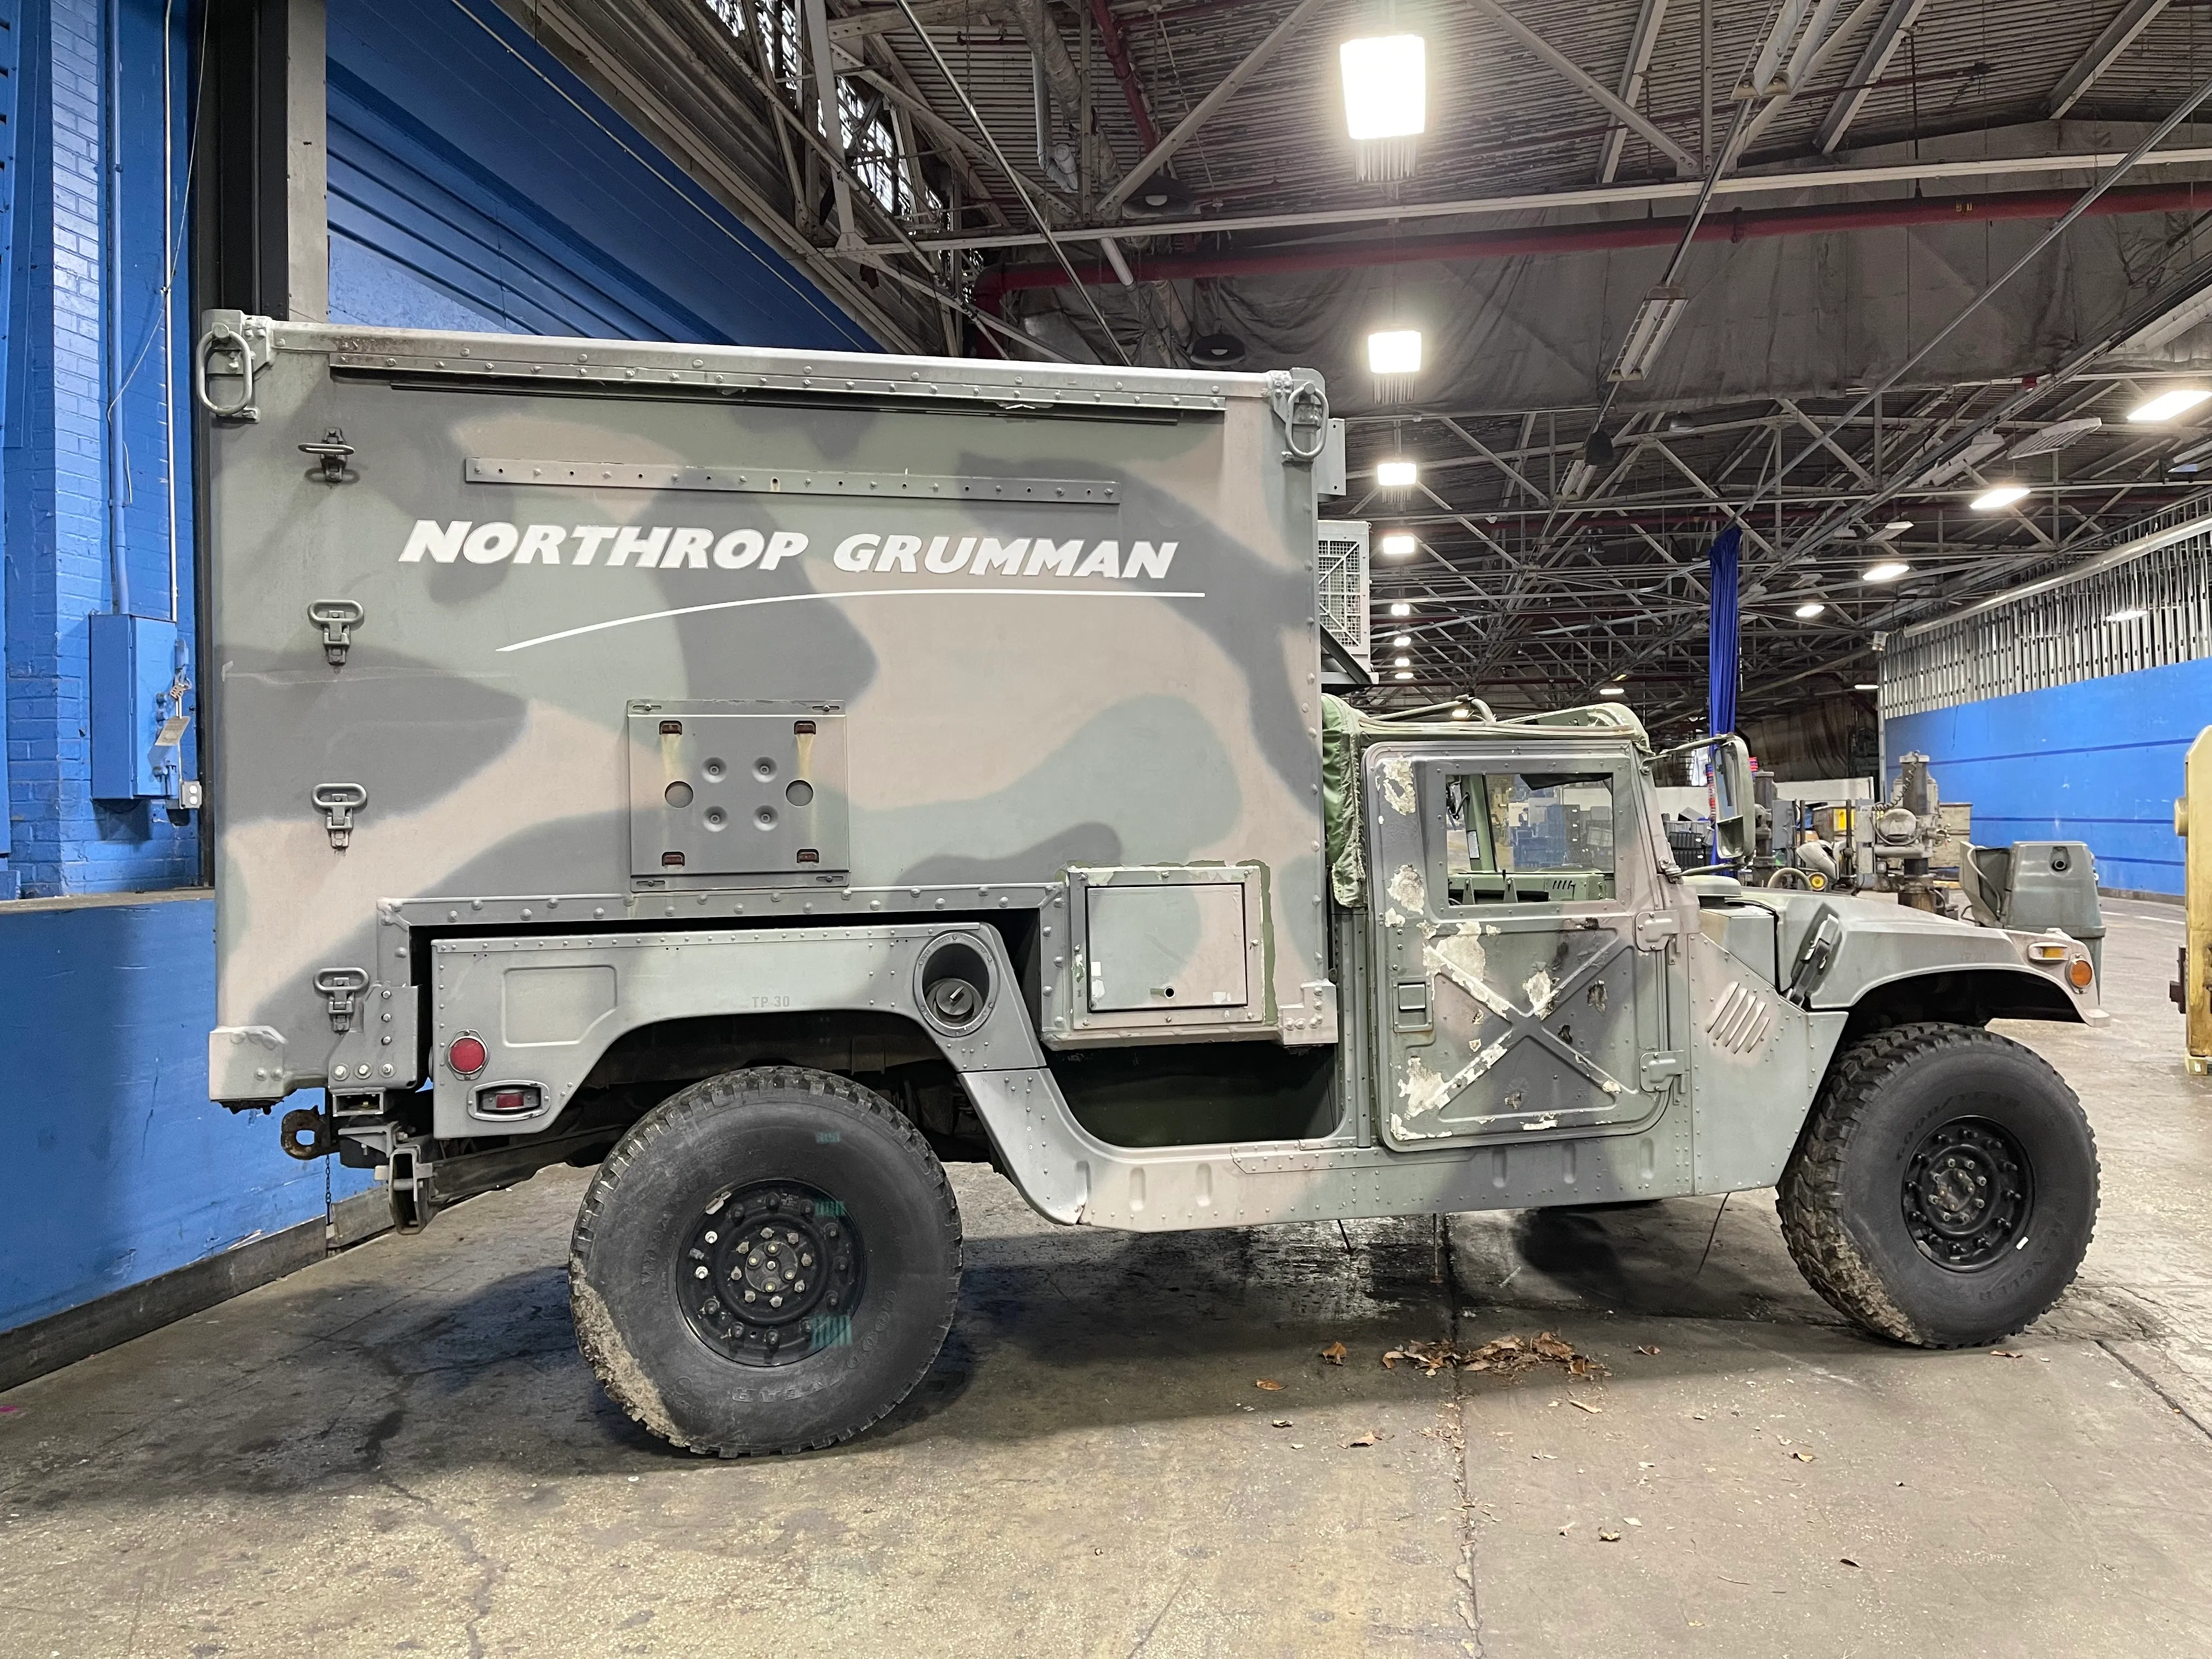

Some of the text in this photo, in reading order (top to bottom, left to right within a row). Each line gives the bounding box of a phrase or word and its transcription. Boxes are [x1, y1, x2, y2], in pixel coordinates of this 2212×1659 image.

[399, 520, 1178, 579] NORTHROP GRUMMAN
[751, 996, 790, 1008] TP 30
